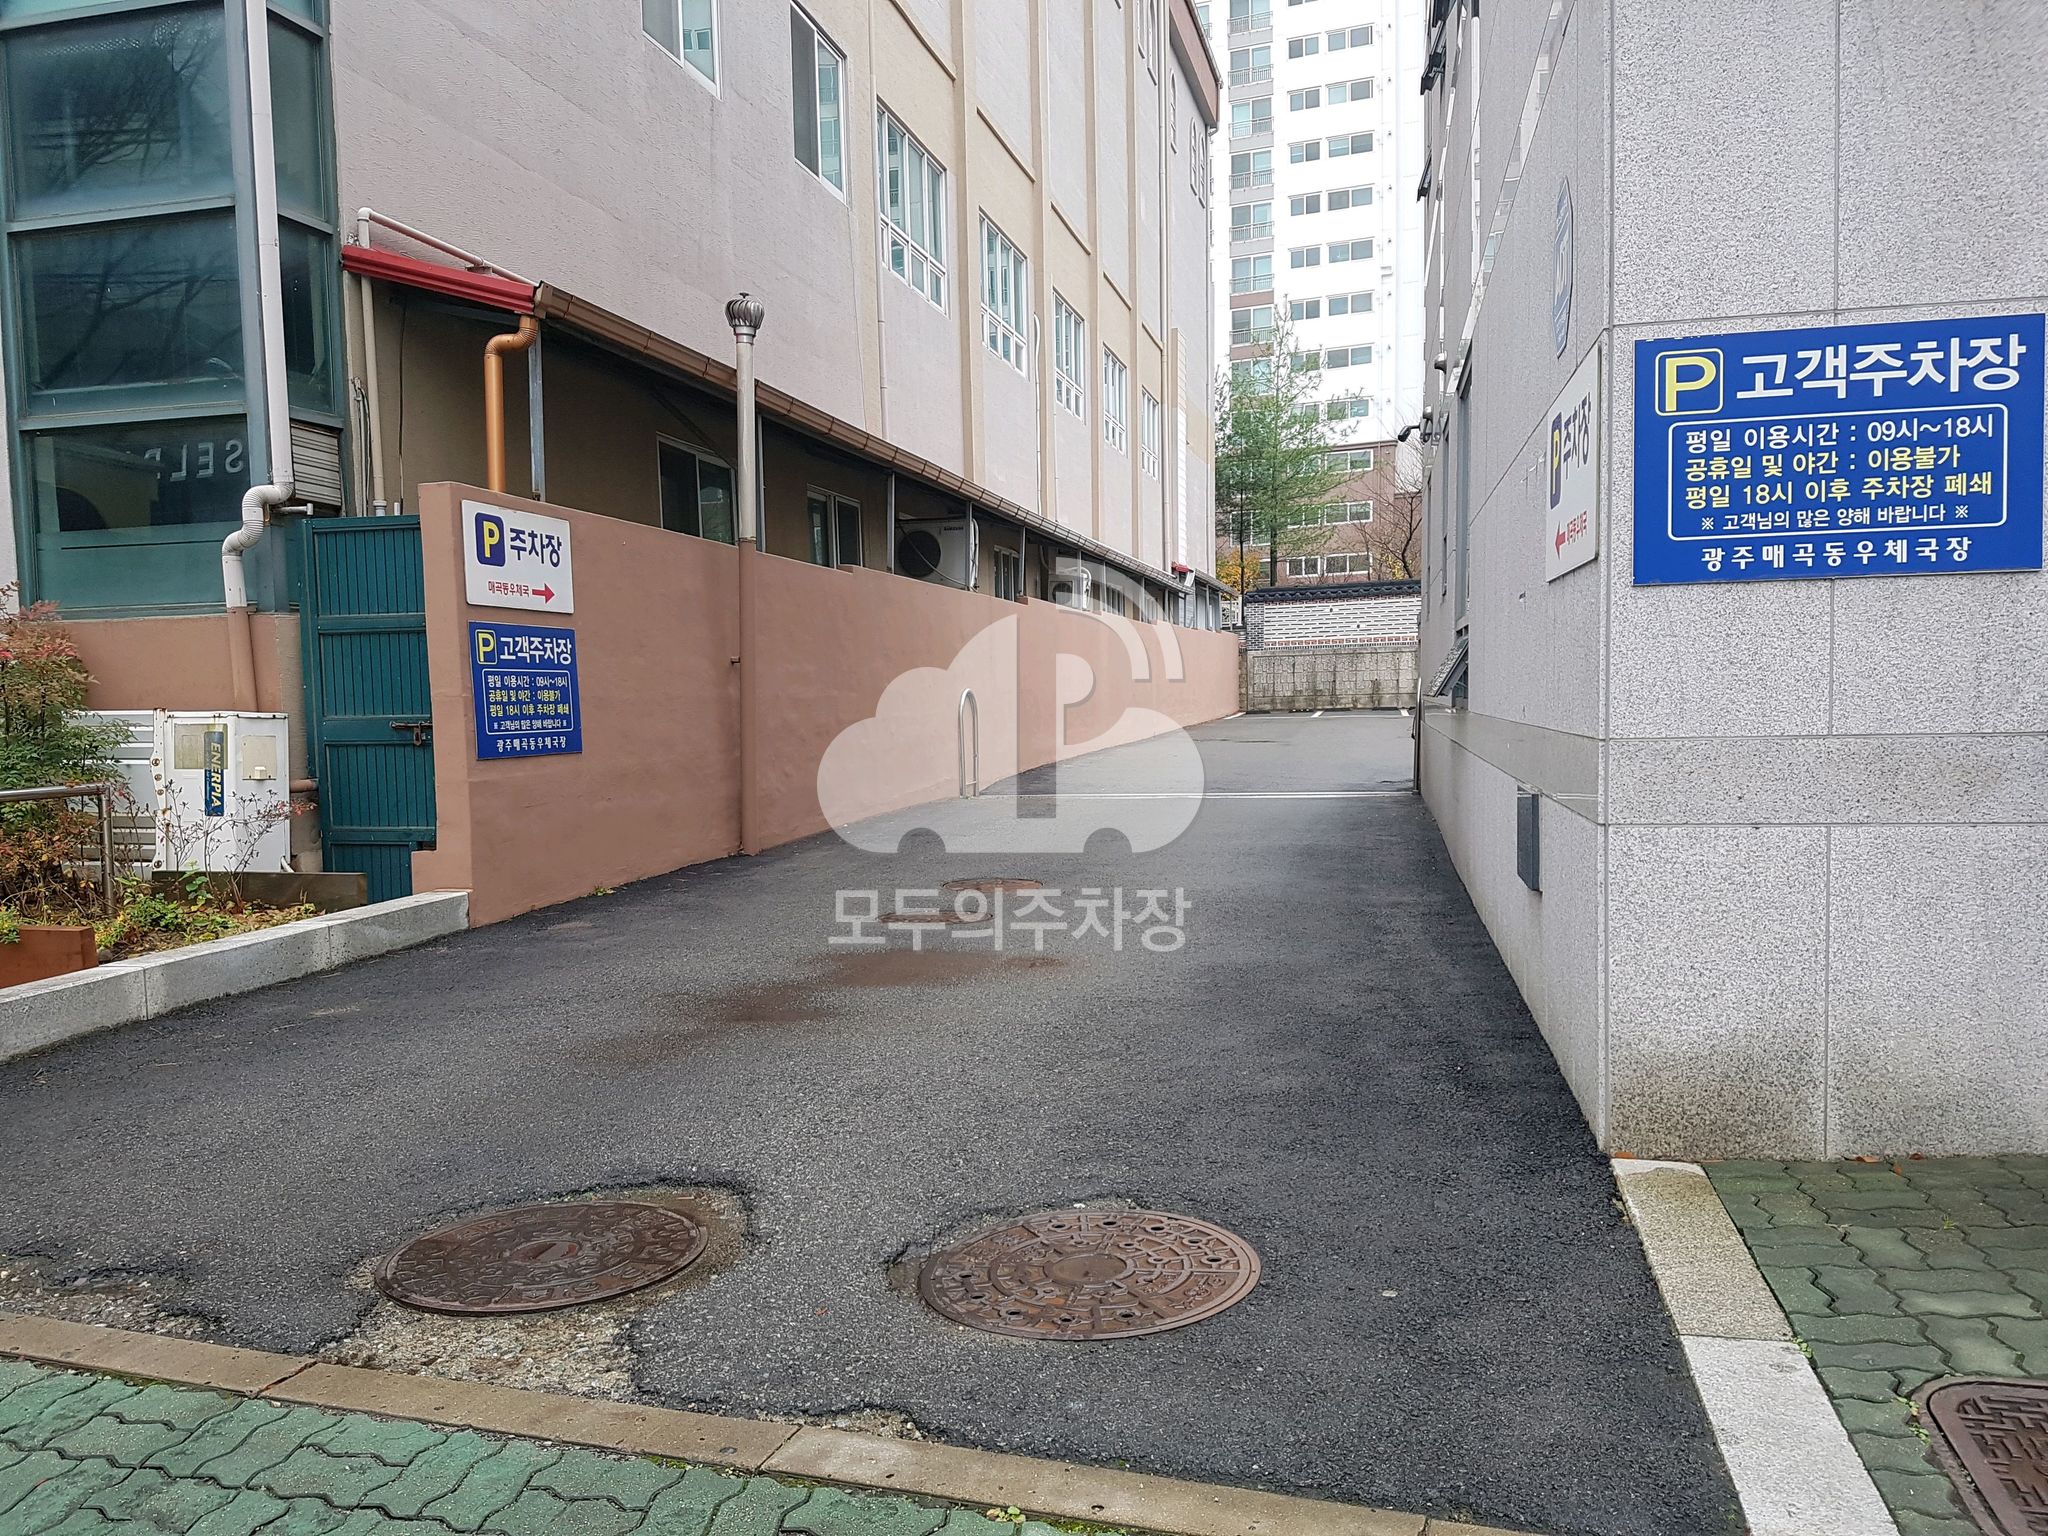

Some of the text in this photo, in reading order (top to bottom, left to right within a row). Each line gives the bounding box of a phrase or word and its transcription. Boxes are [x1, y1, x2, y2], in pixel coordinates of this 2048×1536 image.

[1665, 356, 1717, 412] P
[1736, 333, 2026, 400] 고객주차장
[1563, 391, 1592, 481] 주차장
[1685, 428, 1731, 454] 평일
[1744, 422, 1839, 450] 이용시간
[1867, 413, 1993, 442] 09시~18시
[1685, 455, 1752, 482] 공휴일
[1762, 453, 1783, 477] 및
[1793, 450, 1839, 475] 야간
[1867, 444, 1961, 472] 이용불가
[1685, 471, 1992, 509] 평일 18시 이후 주차장 폐쇄
[1723, 511, 1790, 531] 고객님의
[1796, 509, 1830, 528] 많은
[1837, 506, 1870, 526] 양해
[1877, 503, 1946, 524] 바랍니다
[483, 520, 500, 558] P
[509, 527, 562, 568] 주차장
[1701, 536, 1972, 573] 광주매곡동우체국장
[477, 633, 495, 662] P
[500, 635, 572, 665] 고객주차장
[487, 675, 502, 688] 평일
[503, 675, 530, 688] 이용시간
[488, 689, 508, 702] 공휴일
[517, 690, 531, 702] 야간
[537, 689, 561, 702] 이용불가
[489, 704, 503, 717] 평일
[506, 703, 520, 716] 18시
[522, 703, 535, 715] 이후
[537, 703, 555, 716] 주차장
[210, 742, 222, 807] ENERPIA
